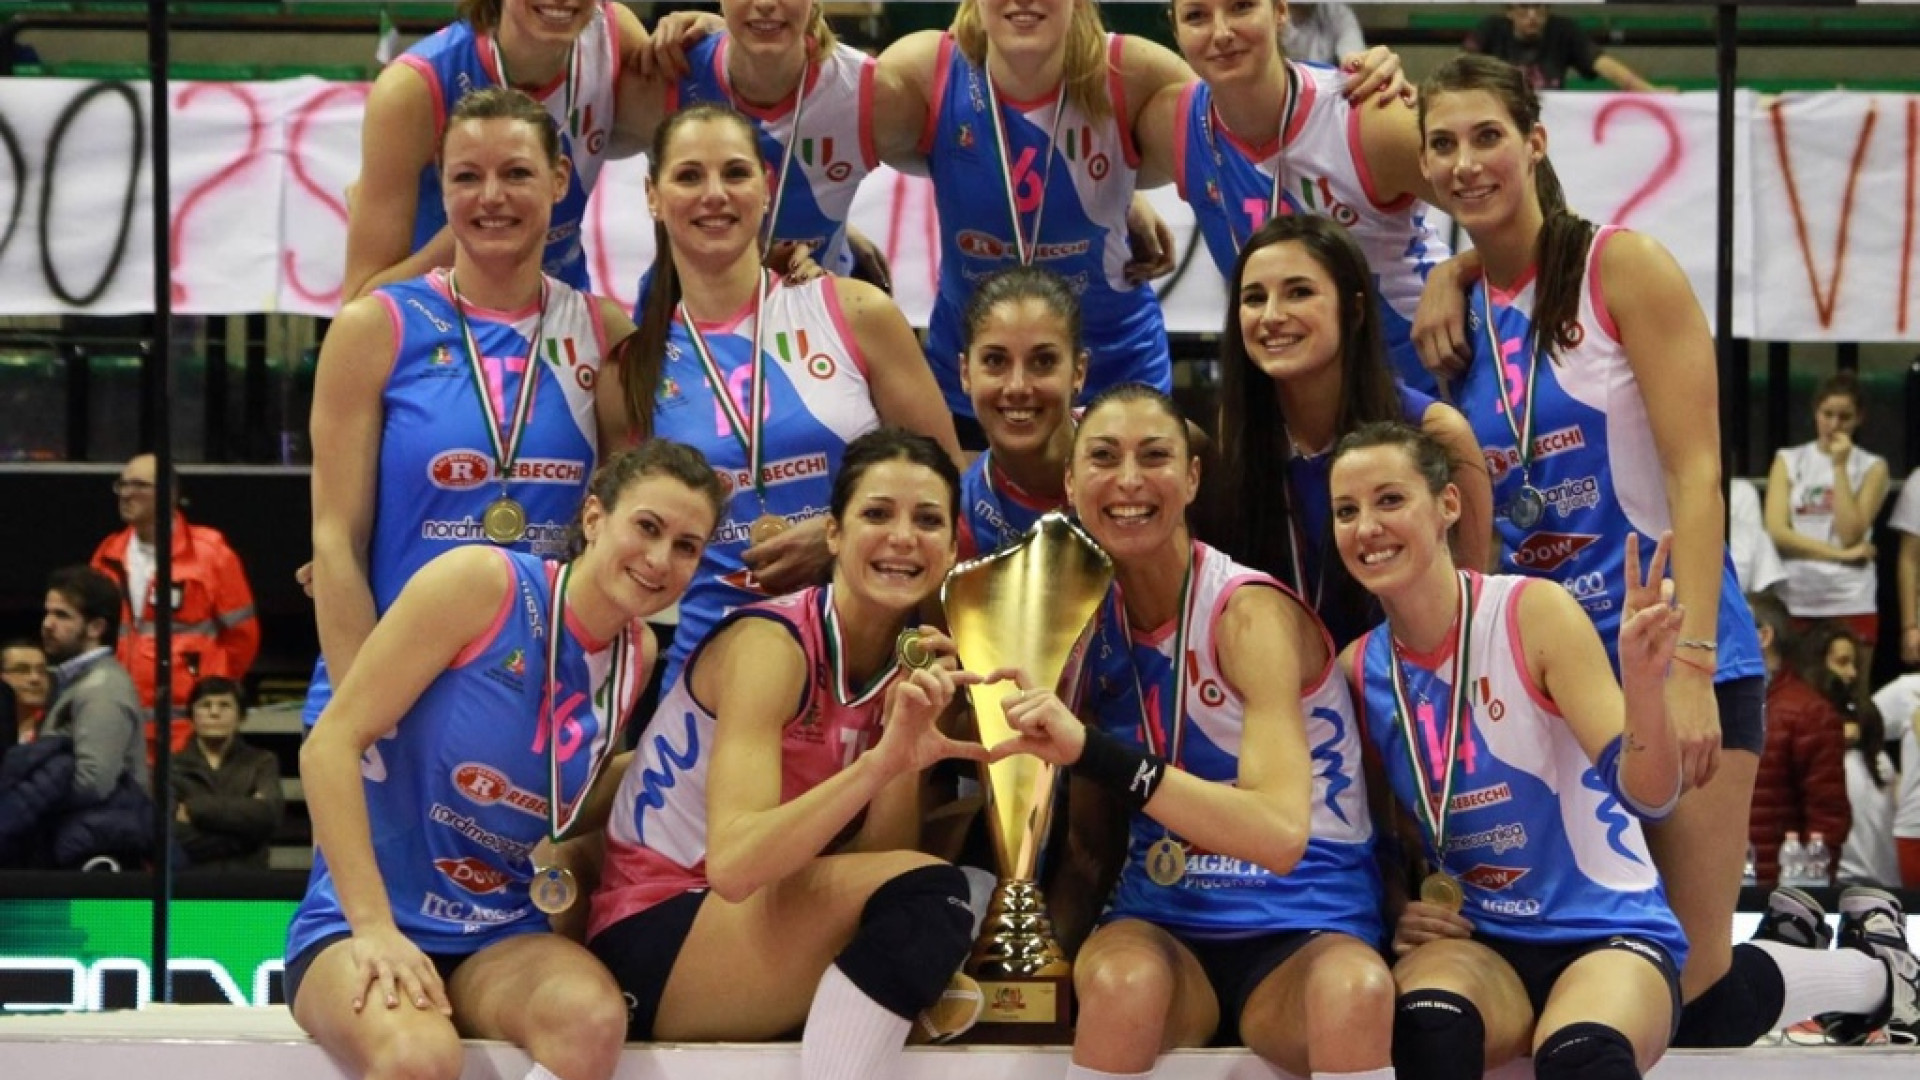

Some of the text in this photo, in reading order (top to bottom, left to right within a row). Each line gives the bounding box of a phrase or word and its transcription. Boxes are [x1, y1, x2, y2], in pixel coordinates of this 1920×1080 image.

[1013, 146, 1045, 213] 6
[704, 362, 771, 438] 10
[1495, 337, 1525, 414] 5
[450, 462, 474, 479] R
[737, 456, 827, 486] RBECCHI
[531, 680, 587, 763] 16
[1416, 701, 1477, 781] 14
